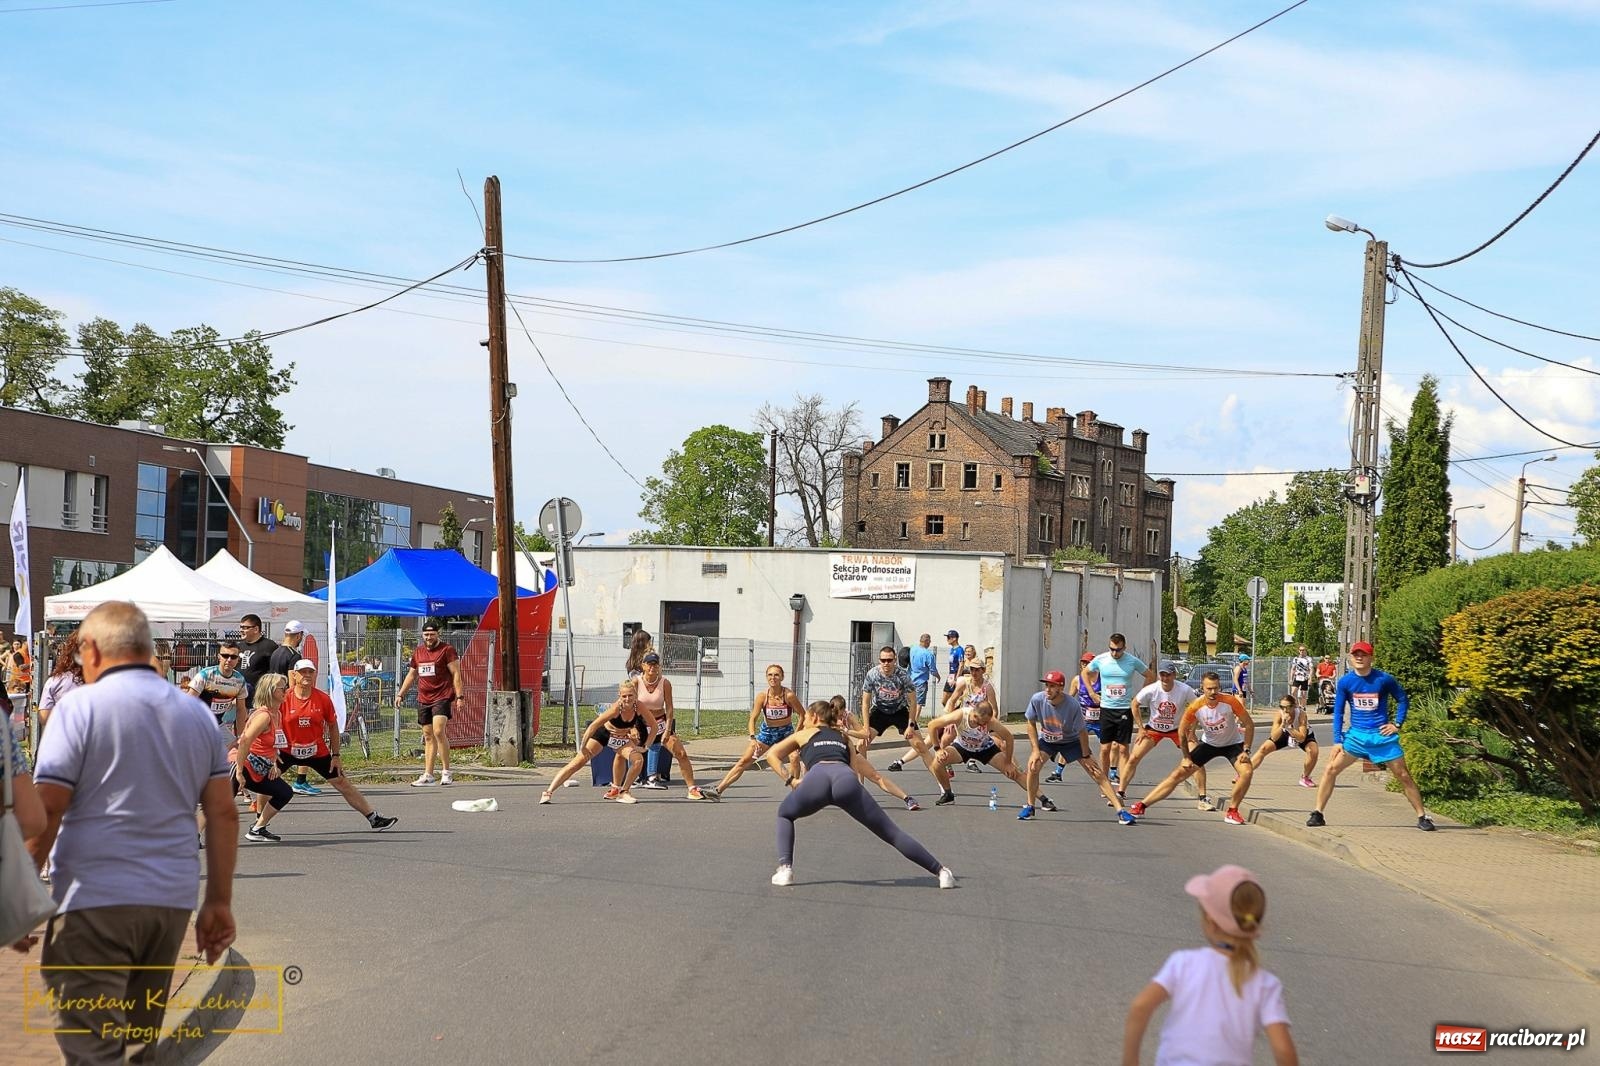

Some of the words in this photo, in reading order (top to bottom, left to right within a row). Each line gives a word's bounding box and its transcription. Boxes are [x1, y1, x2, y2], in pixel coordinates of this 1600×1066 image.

[841, 555, 869, 564] TRWA
[872, 555, 903, 565] NABÓR
[833, 564, 860, 574] Sekcja
[862, 565, 911, 574] Podnoszenia
[1208, 724, 1225, 732] 144
[296, 747, 313, 756] 162
